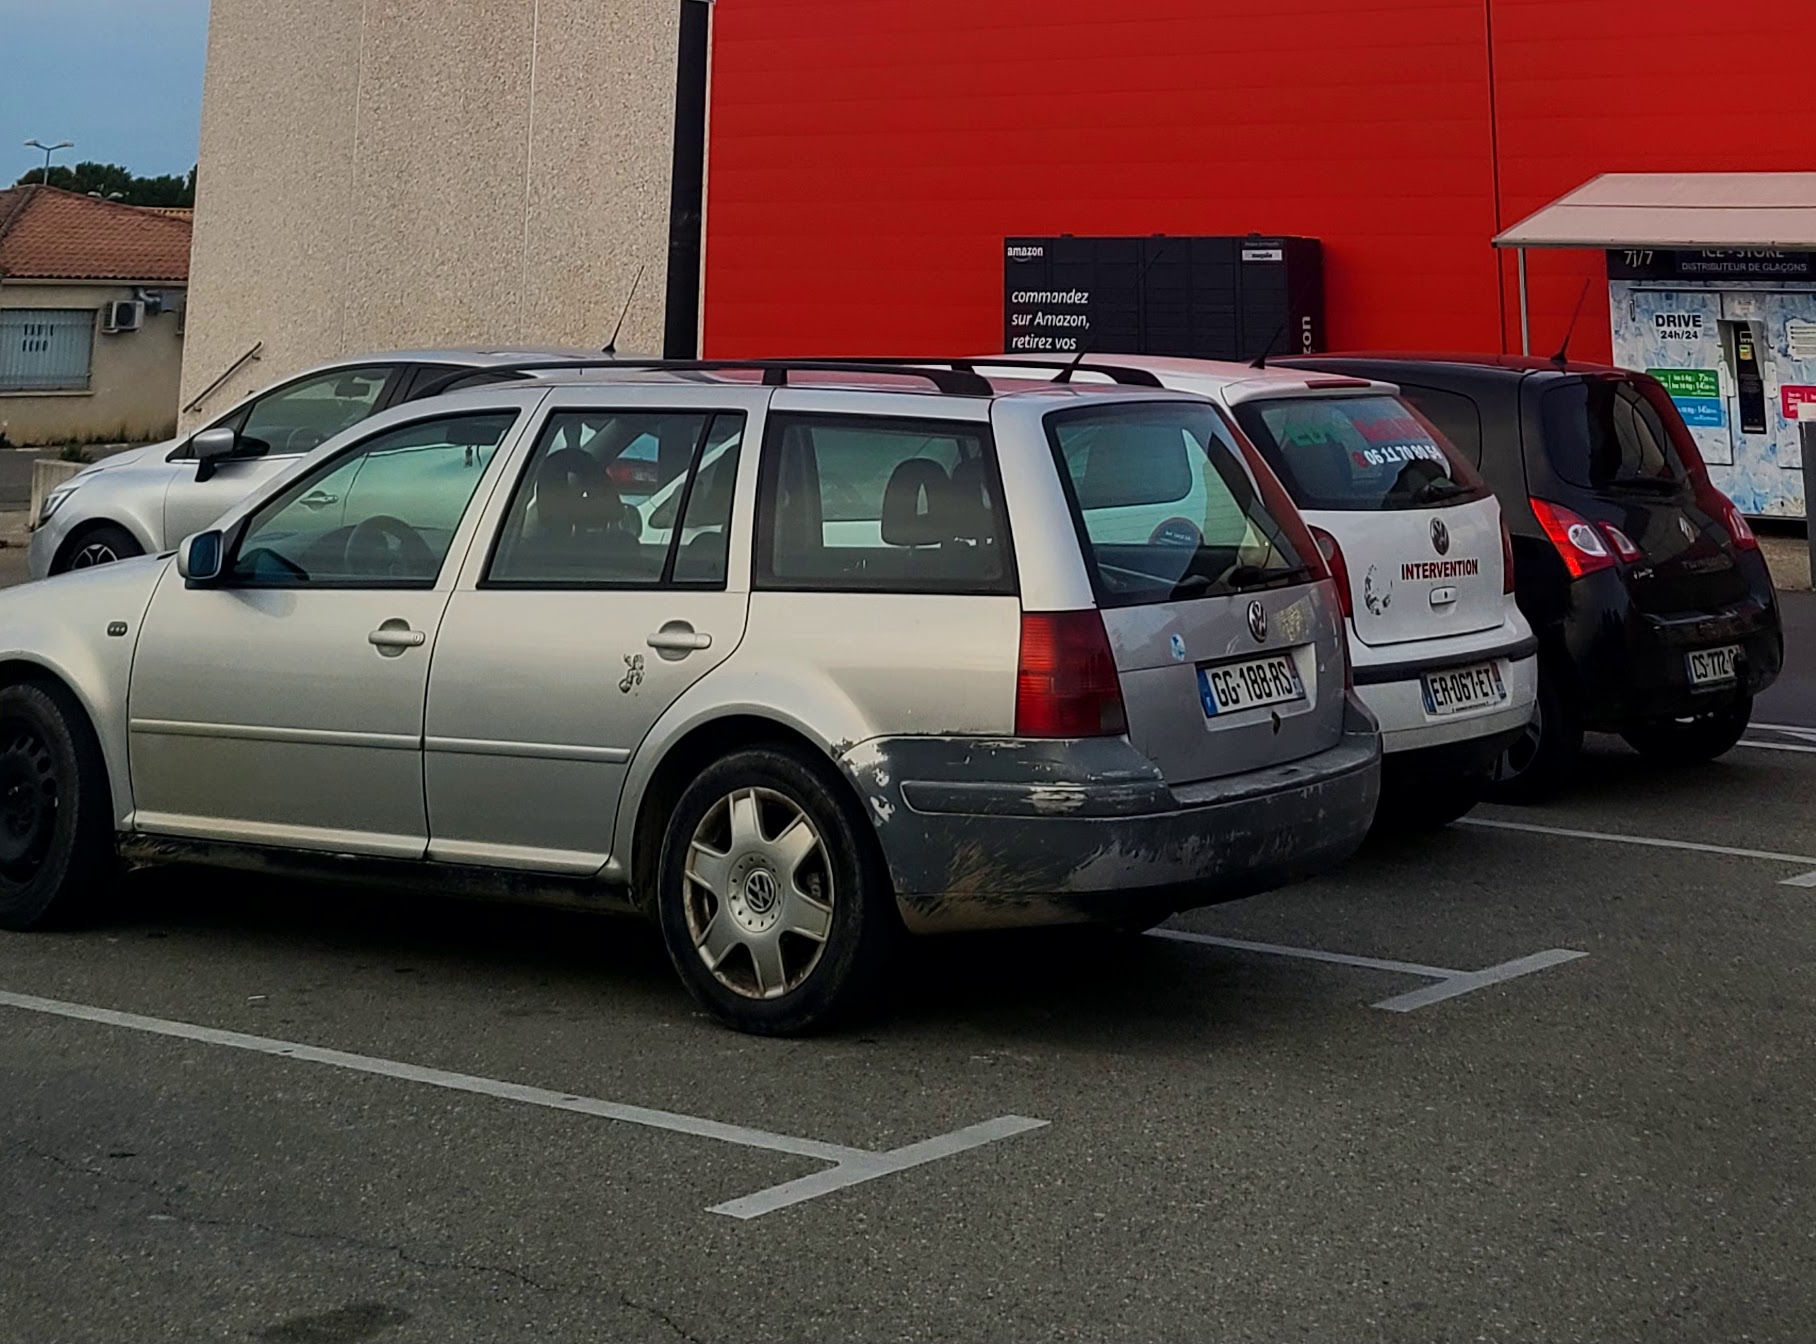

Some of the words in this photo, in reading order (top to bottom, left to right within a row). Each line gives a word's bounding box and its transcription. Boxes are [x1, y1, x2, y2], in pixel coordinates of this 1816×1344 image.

[1007, 247, 1043, 256] amazon
[1624, 249, 1653, 267] 7j/7
[1682, 262, 1746, 271] DISTRIBUTEUR
[1748, 263, 1760, 271] DE
[1762, 263, 1807, 272] GLAÇONS
[1011, 288, 1089, 304] commandez
[1011, 313, 1032, 326] sur
[1034, 311, 1090, 330] Amazon,
[1655, 314, 1702, 328] DRIVE
[1012, 333, 1052, 349] retirez
[1055, 337, 1077, 350] vos
[1660, 330, 1699, 340] 24h/24
[1401, 558, 1478, 581] INTERVENTION
[1211, 661, 1293, 707] GG-188-RS
[1430, 668, 1495, 707] ER-067-ET
